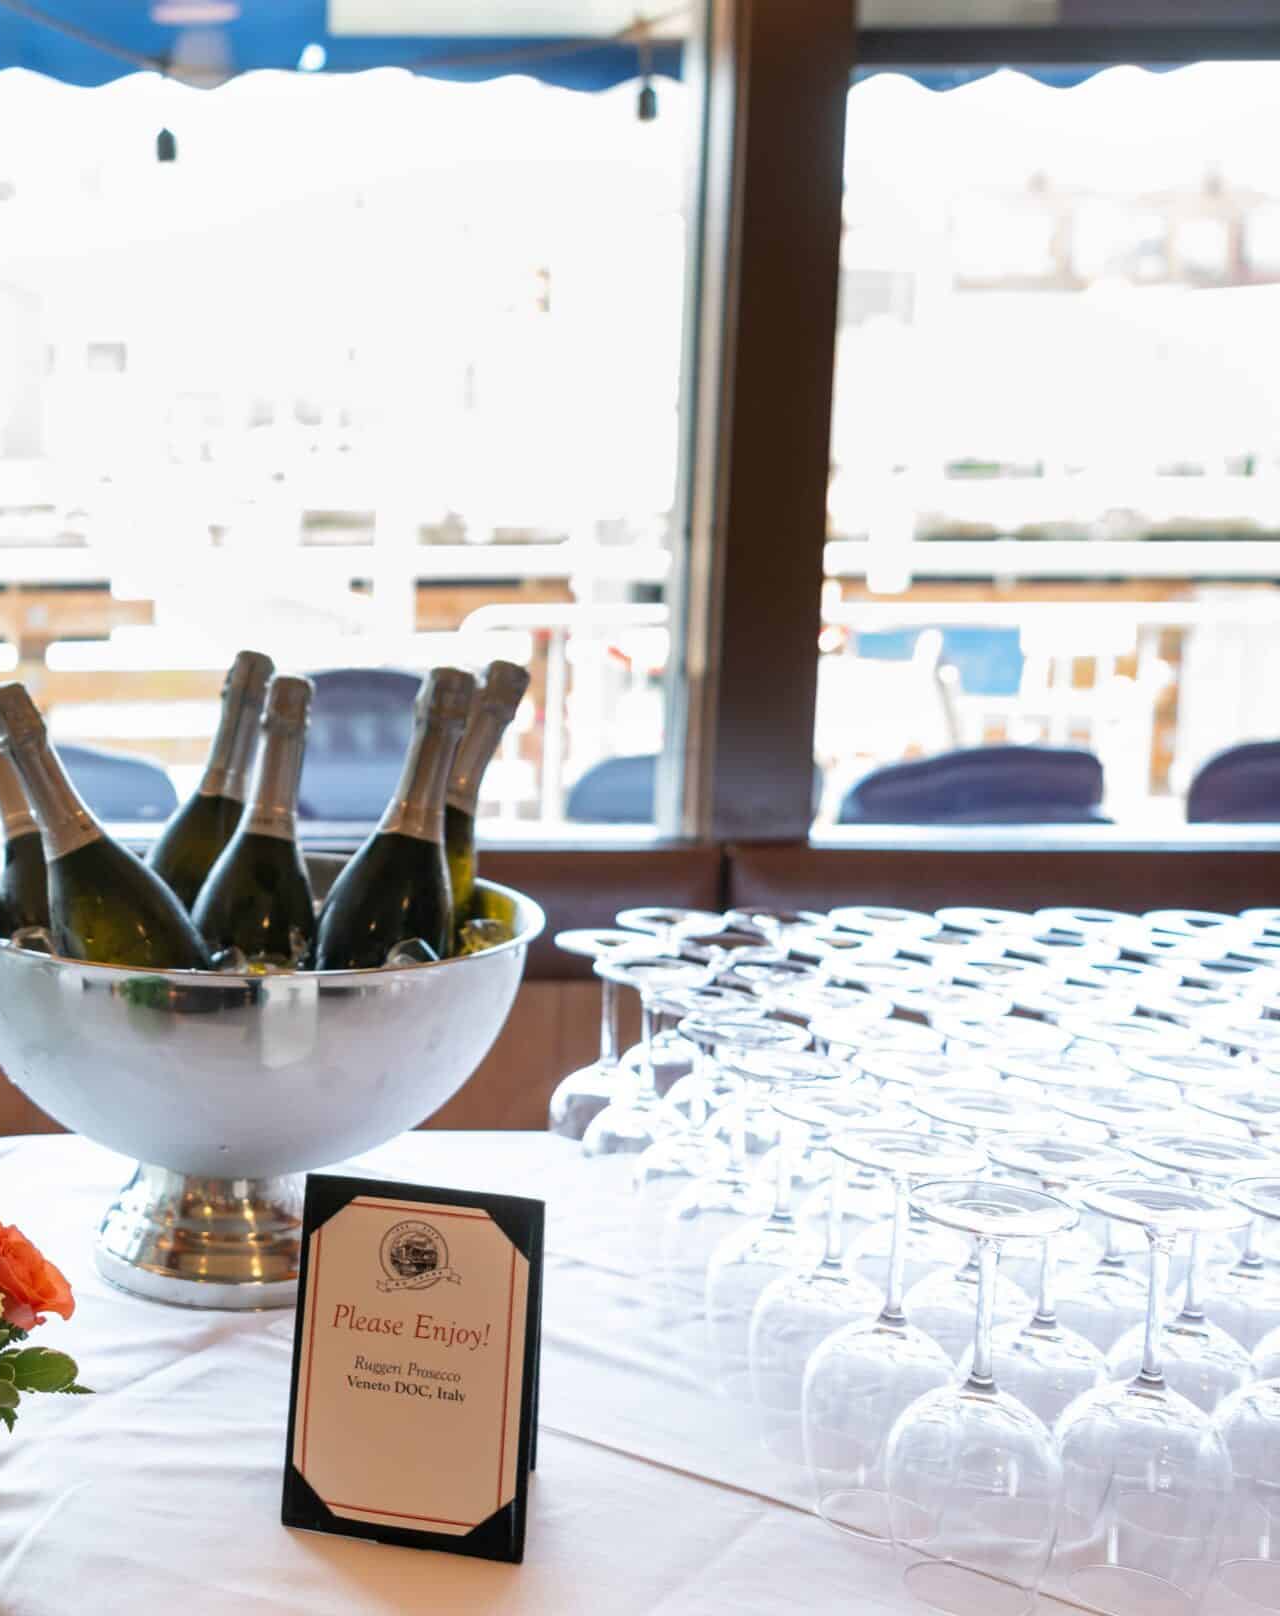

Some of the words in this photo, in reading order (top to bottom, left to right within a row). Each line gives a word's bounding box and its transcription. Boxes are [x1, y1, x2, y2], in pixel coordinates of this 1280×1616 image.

[332, 1303, 404, 1336] Please
[414, 1313, 491, 1351] Enjoy!
[407, 1361, 461, 1383] Prosecco
[346, 1375, 391, 1393] Veneto
[394, 1381, 433, 1399] DOC,
[437, 1386, 466, 1403] Italy
